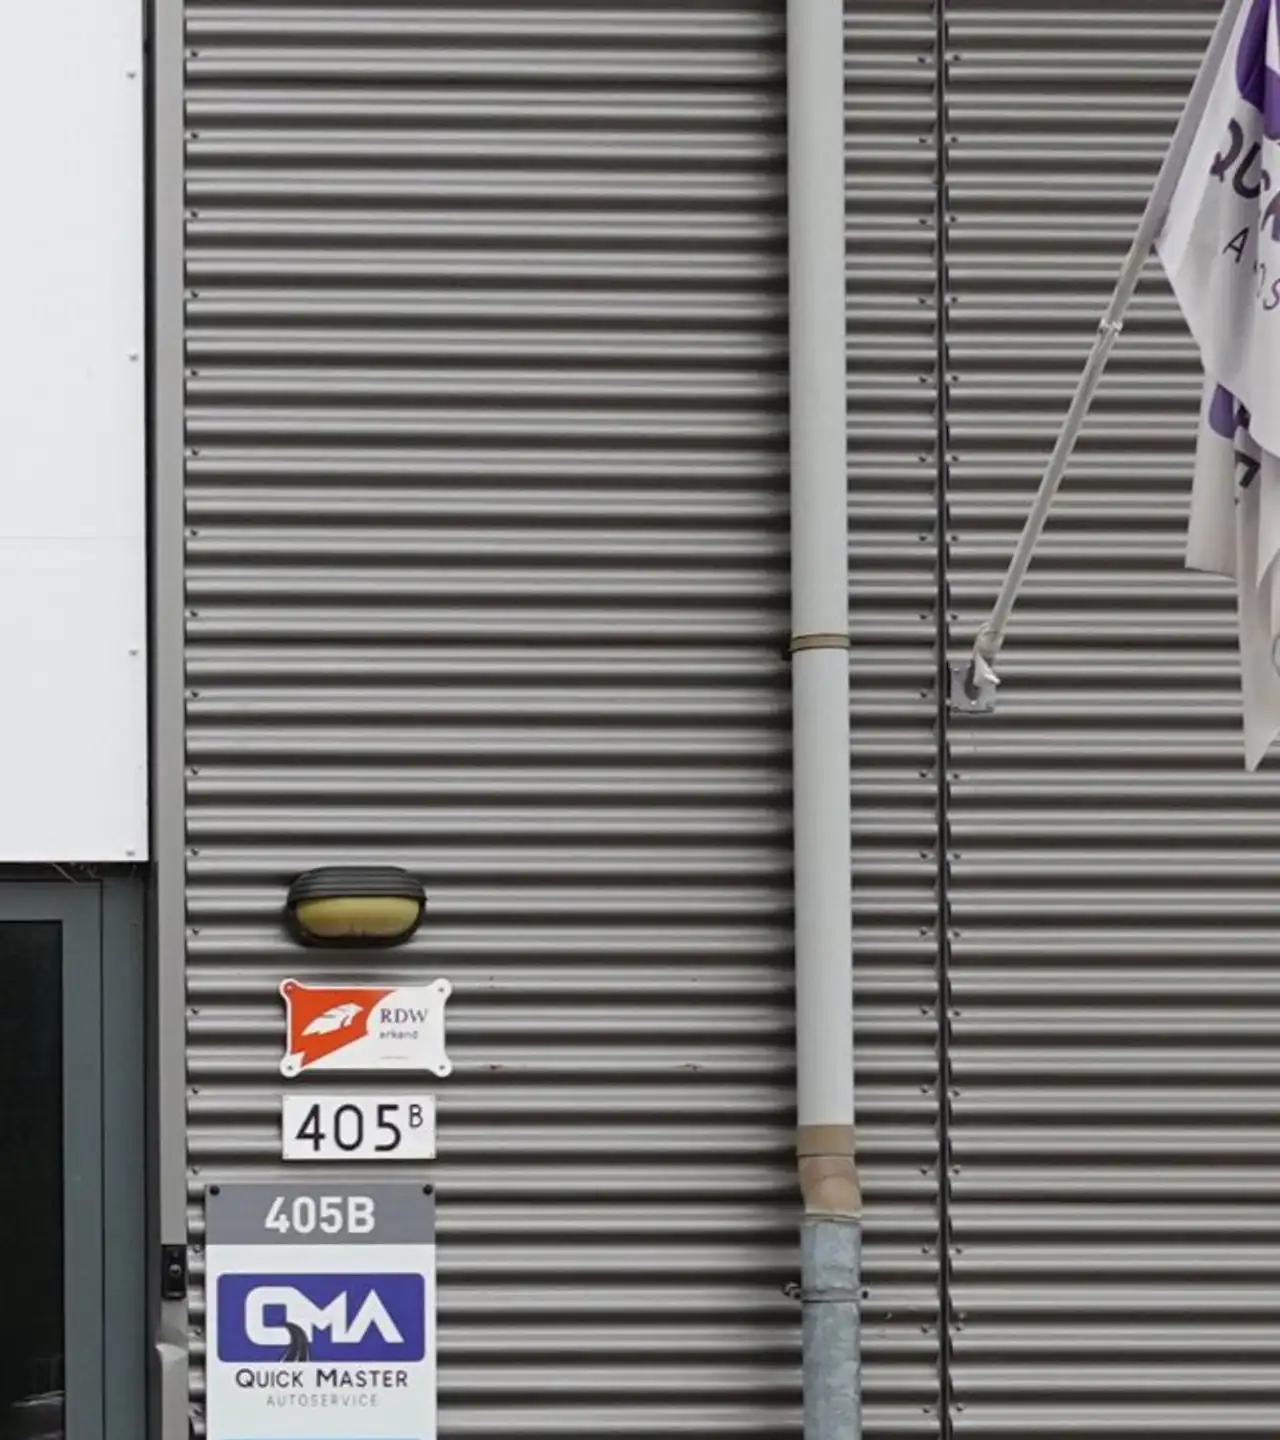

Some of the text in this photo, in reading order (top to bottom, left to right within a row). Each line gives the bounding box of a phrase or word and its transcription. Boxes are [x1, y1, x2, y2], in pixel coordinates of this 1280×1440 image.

[380, 1007, 428, 1024] RDW
[264, 1196, 375, 1234] 405B
[245, 1286, 404, 1346] QMA
[235, 1368, 408, 1389] QUICK MASTER
[266, 1393, 378, 1408] AUTOSERVICE
